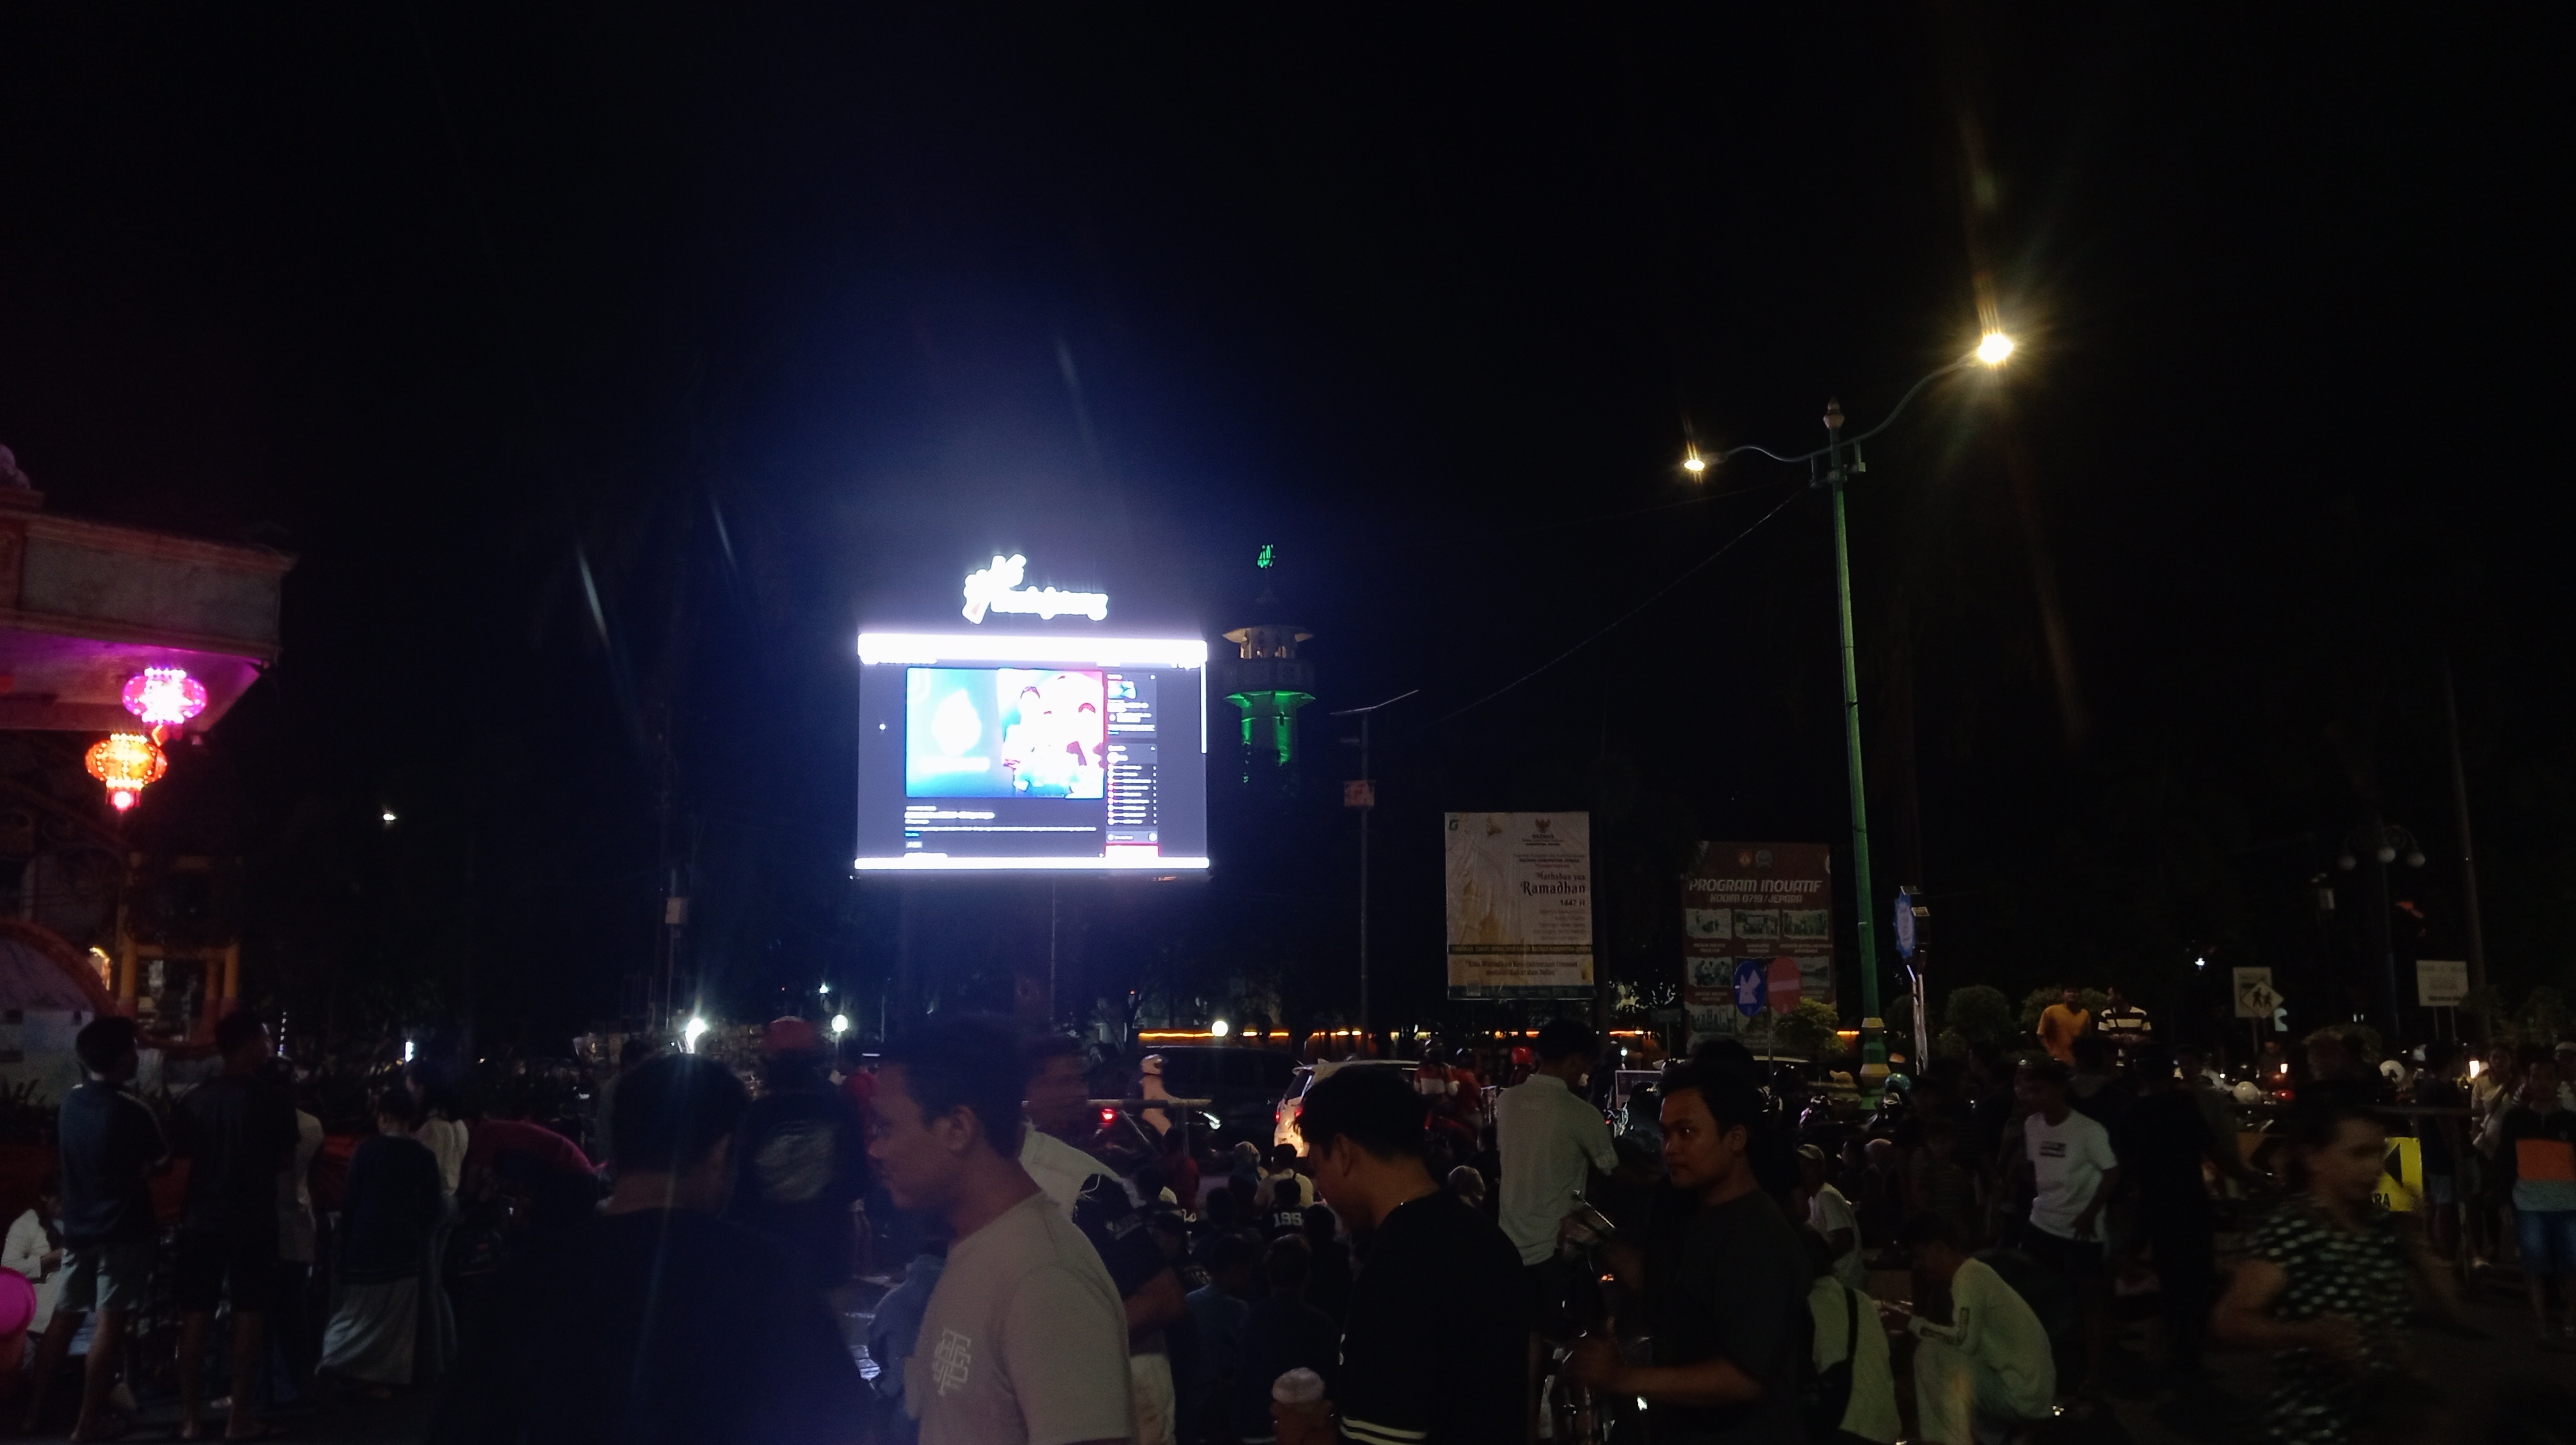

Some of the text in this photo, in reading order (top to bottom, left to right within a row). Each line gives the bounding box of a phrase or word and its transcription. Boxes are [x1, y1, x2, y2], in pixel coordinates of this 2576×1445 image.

[1535, 871, 1571, 880] Marhaban
[1520, 881, 1585, 896] Ramadhan
[1689, 878, 1757, 892] PROGRAM
